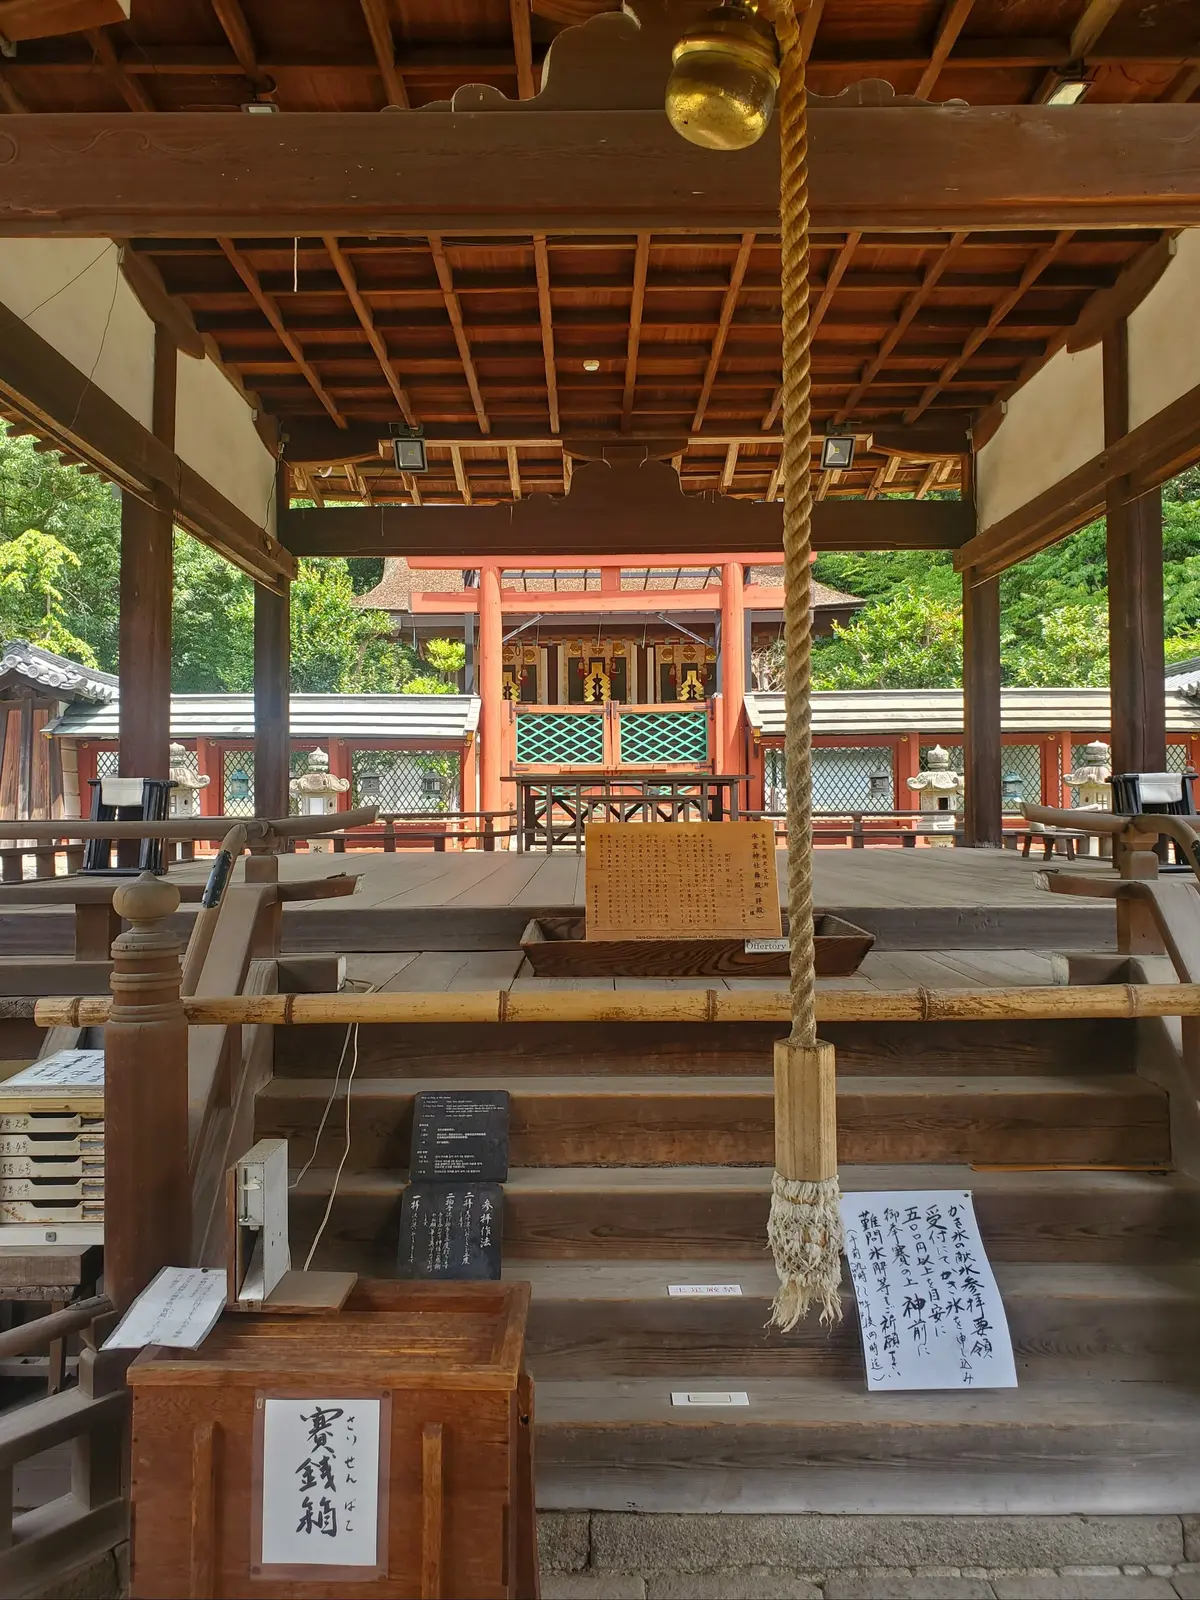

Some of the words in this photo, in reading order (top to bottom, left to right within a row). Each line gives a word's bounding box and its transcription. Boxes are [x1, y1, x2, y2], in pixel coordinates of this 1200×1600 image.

[746, 941, 787, 951] Offertory
[480, 1198, 494, 1248] 参拝作法
[947, 1204, 993, 1359] かき氷の献氷参拝要領
[295, 1406, 345, 1537] 賽銭箱
[344, 1416, 357, 1532] さいせんばこ
